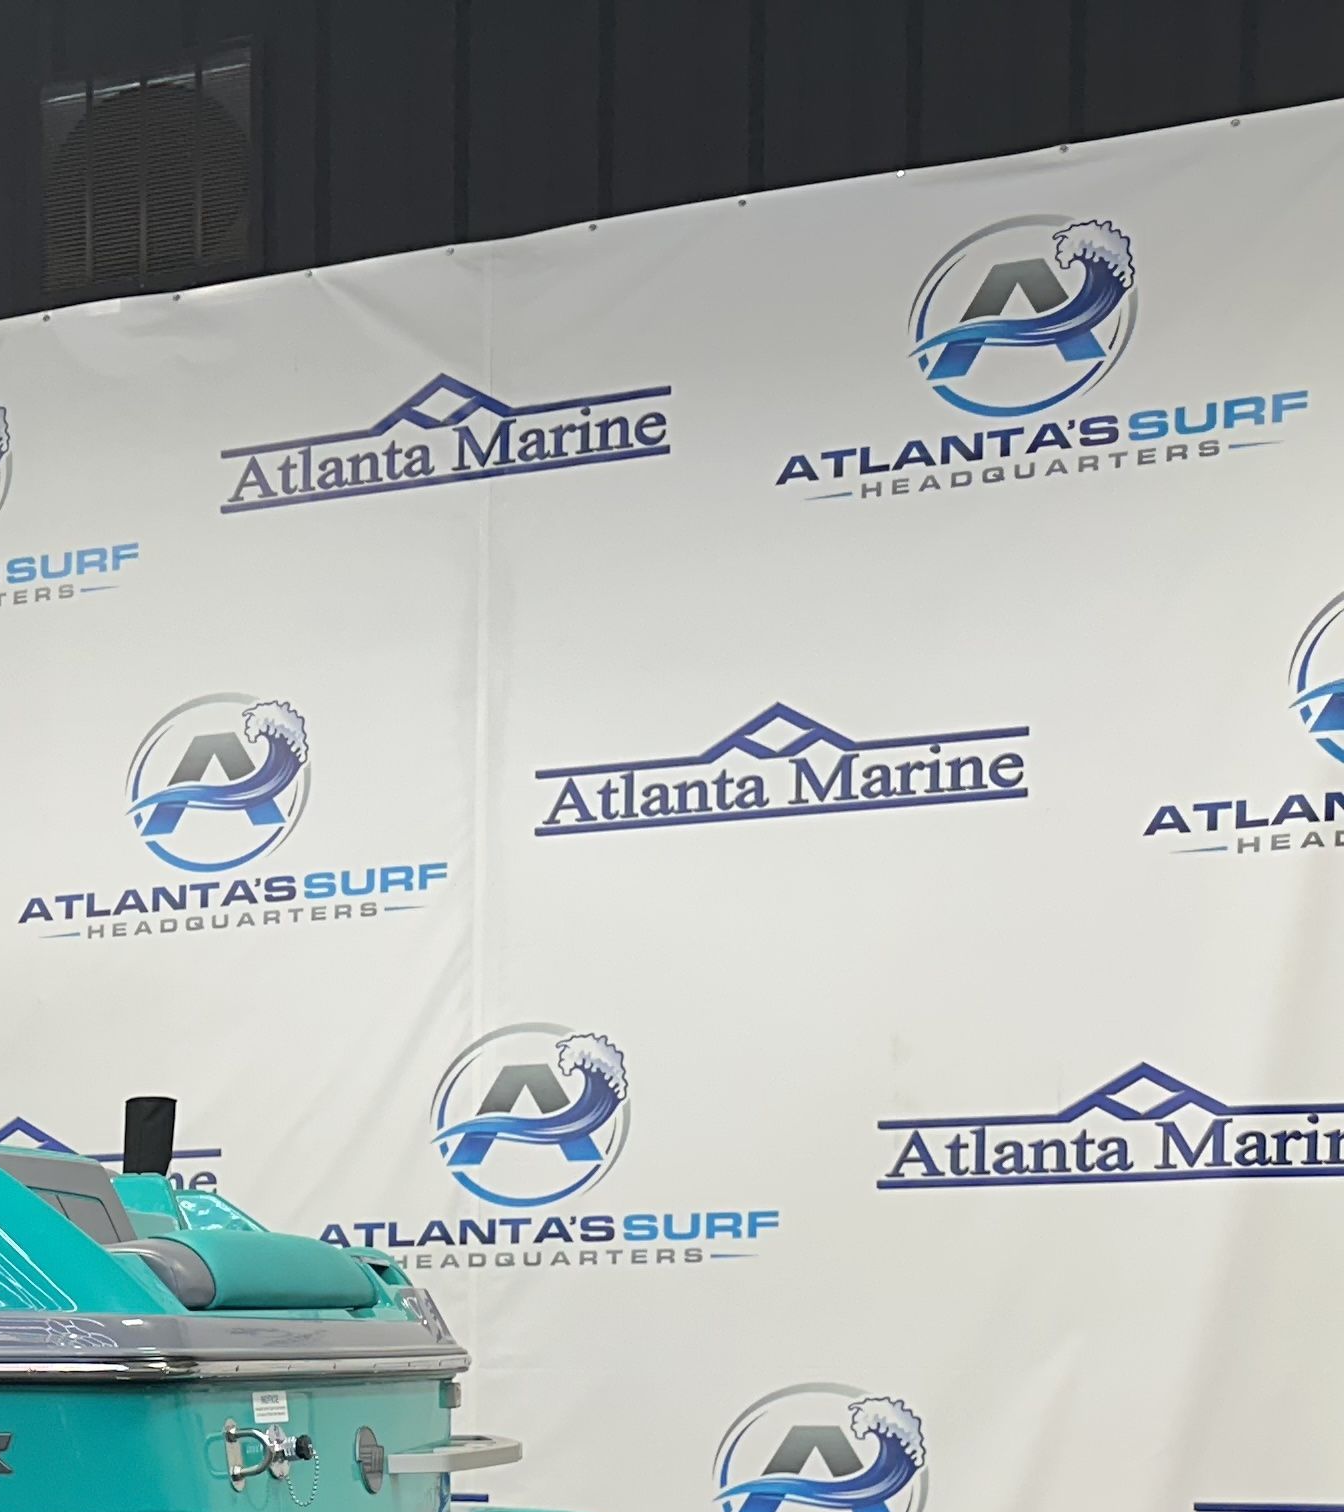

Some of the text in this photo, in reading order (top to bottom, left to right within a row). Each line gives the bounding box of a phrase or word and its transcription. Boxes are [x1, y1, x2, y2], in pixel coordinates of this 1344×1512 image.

[1128, 390, 1309, 441] SURF
[227, 406, 667, 503] Atlanta Marine
[861, 440, 1221, 499] HEADQUARTERS
[6, 542, 139, 585] SURF
[542, 743, 1024, 825] Atlanta Marine
[303, 862, 448, 900] SURF
[87, 902, 377, 939] HEADQUARTERS
[885, 1125, 1134, 1177] Atlanta
[623, 1210, 779, 1242] SURF
